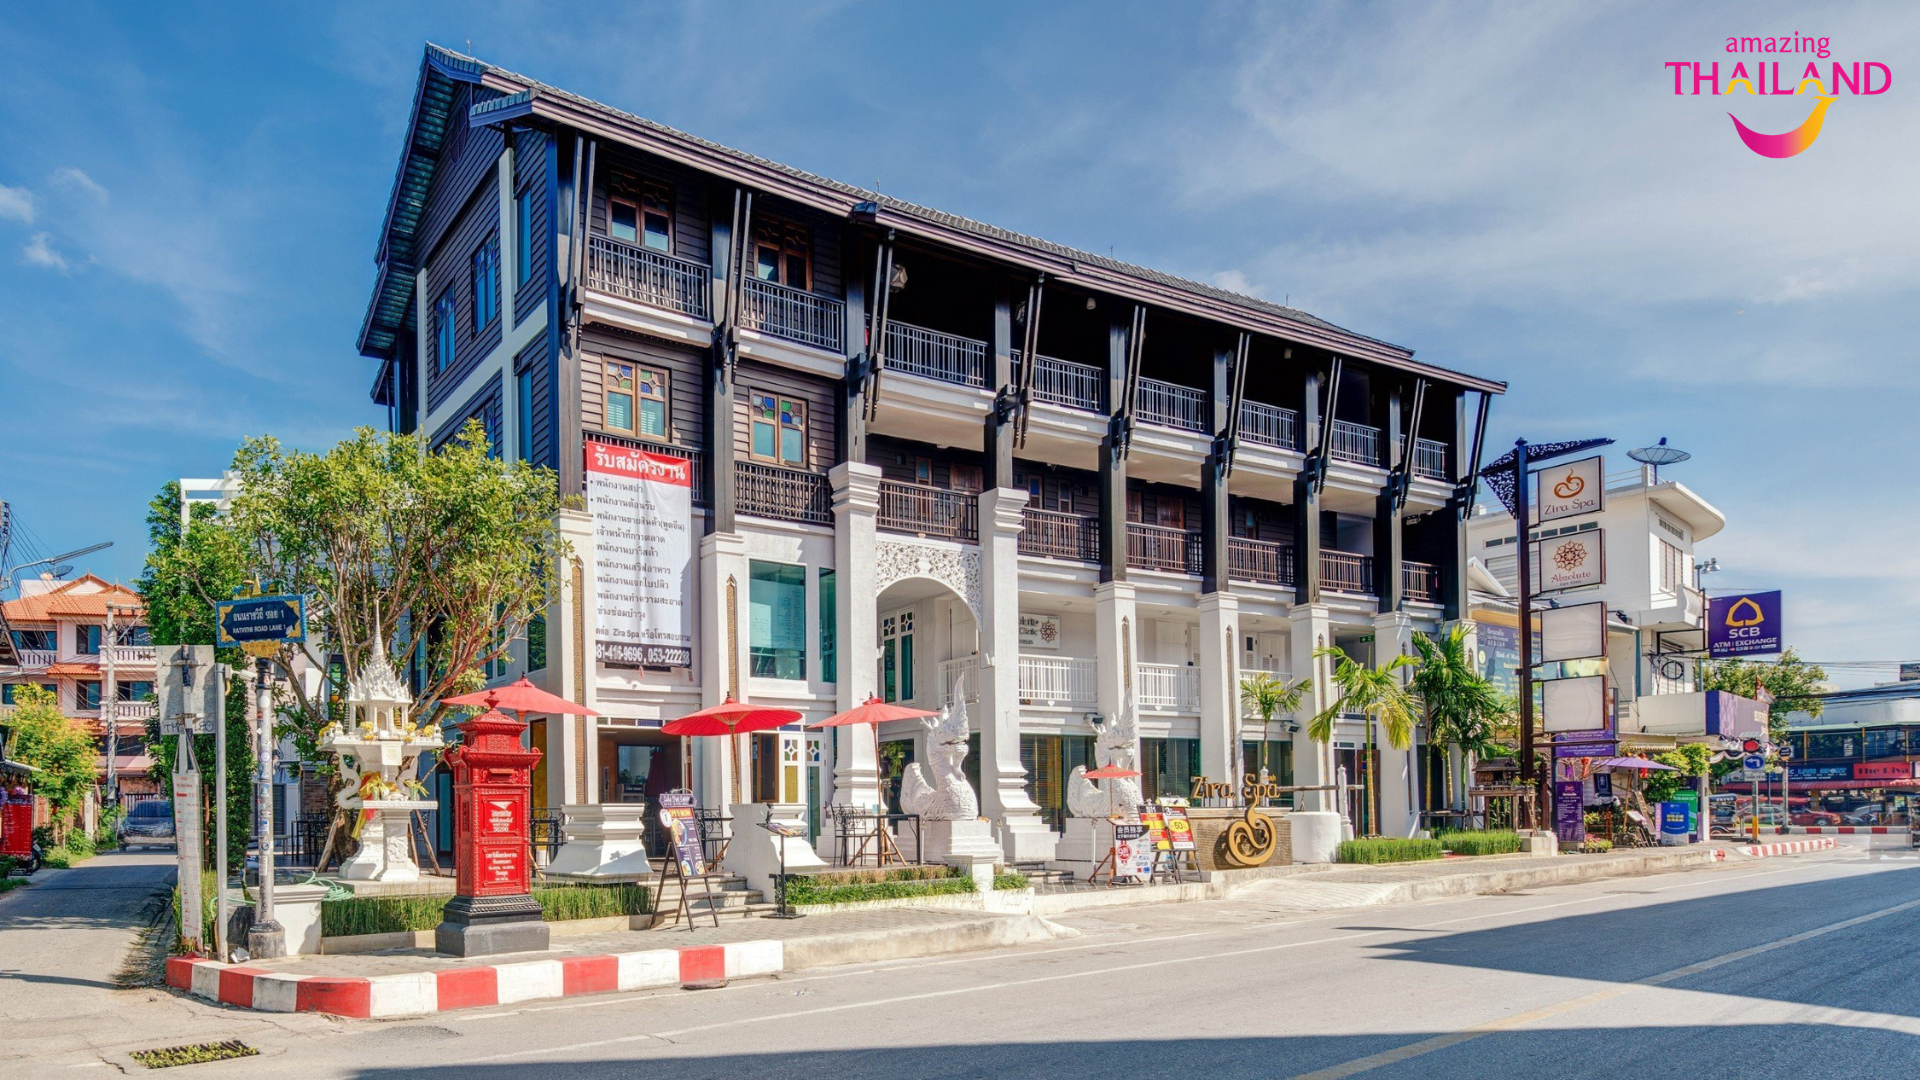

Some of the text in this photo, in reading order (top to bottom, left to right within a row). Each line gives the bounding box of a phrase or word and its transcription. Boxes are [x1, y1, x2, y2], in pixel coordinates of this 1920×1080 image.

[594, 445, 686, 480] รับสมัครงาน
[596, 478, 643, 493] พนักงานสปา
[596, 495, 656, 511] พนักงานต้อนรับ
[1544, 498, 1595, 515] Zira Spa
[1551, 571, 1591, 583] Absolute
[254, 625, 268, 633] ROAD
[612, 628, 626, 637] Zira
[626, 629, 640, 639] Spa
[1728, 626, 1761, 639] SCB
[1735, 637, 1777, 646] EXCHANGE
[1858, 767, 1880, 775] The
[1191, 773, 1280, 802] Zira Spa
